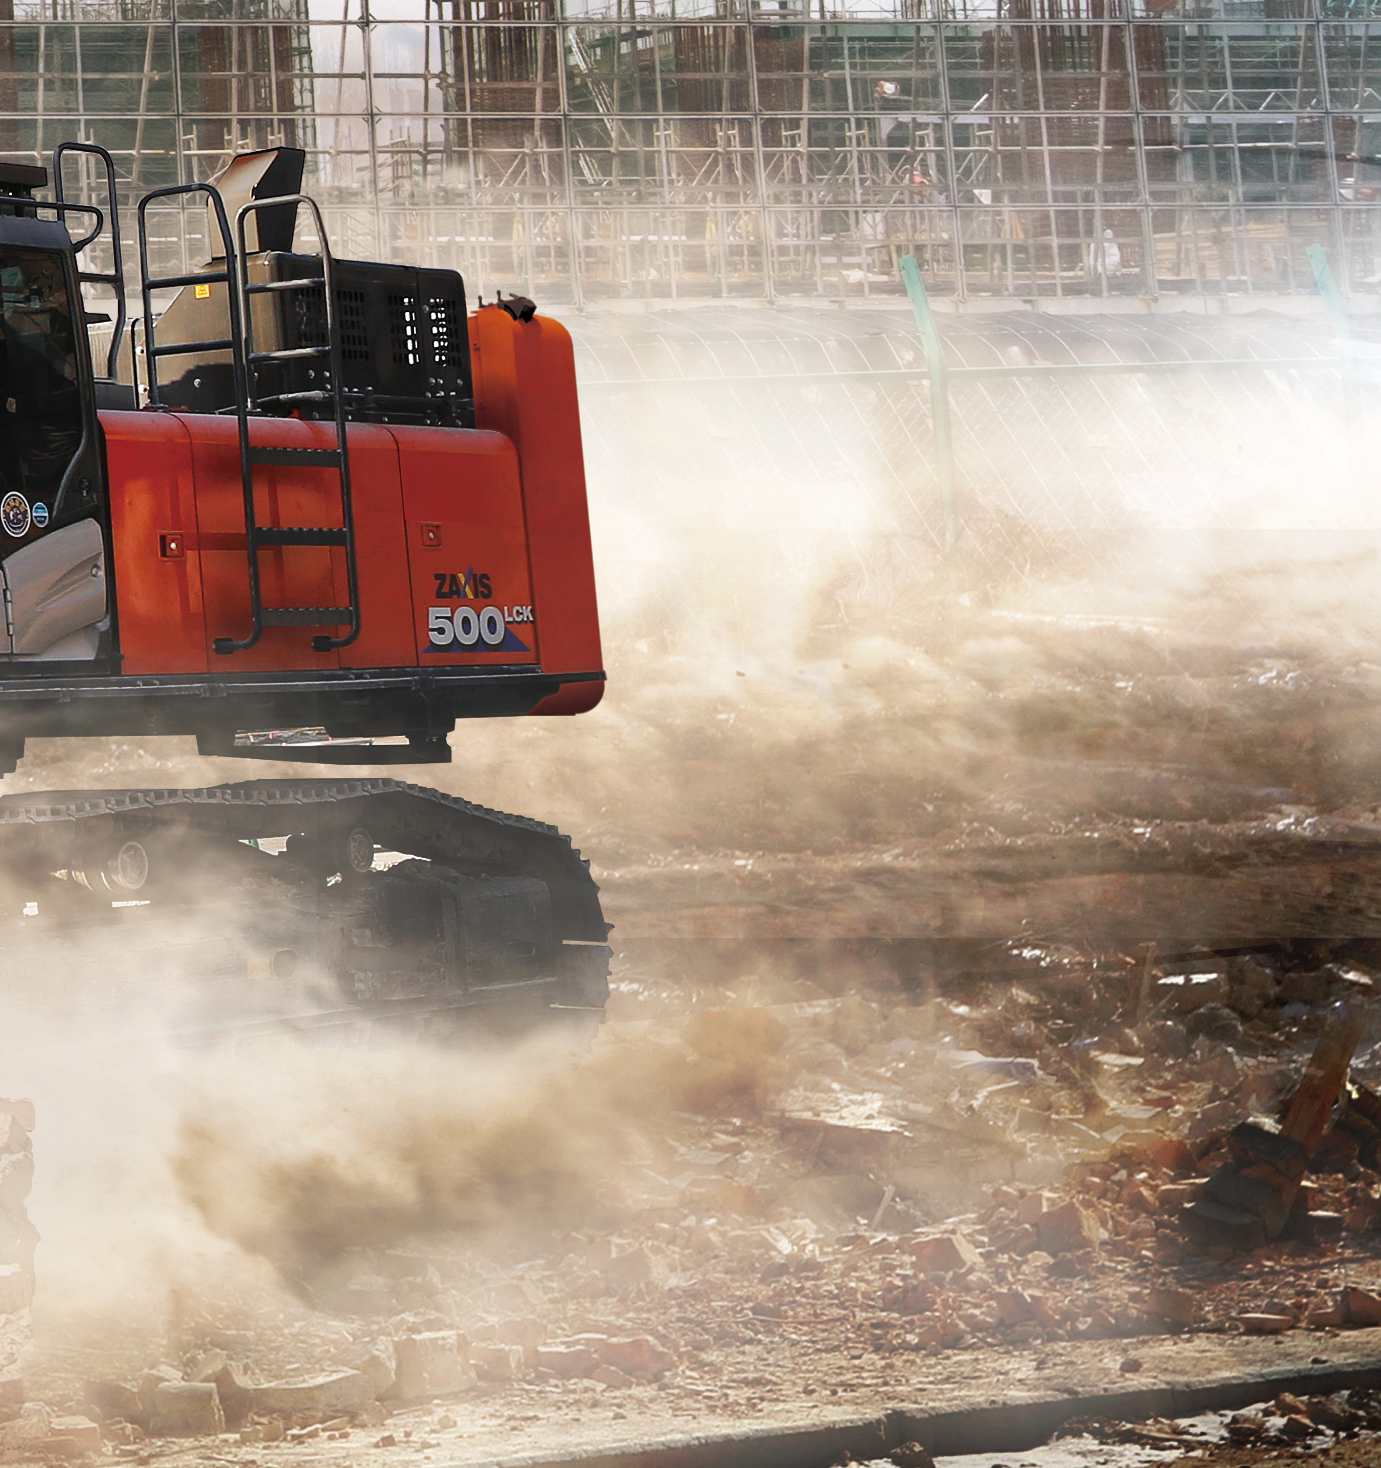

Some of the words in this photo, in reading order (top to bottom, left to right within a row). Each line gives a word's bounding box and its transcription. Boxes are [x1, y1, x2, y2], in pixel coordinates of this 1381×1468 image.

[434, 567, 493, 599] ZAXIS
[428, 606, 505, 645] 500
[504, 605, 534, 623] LCK
